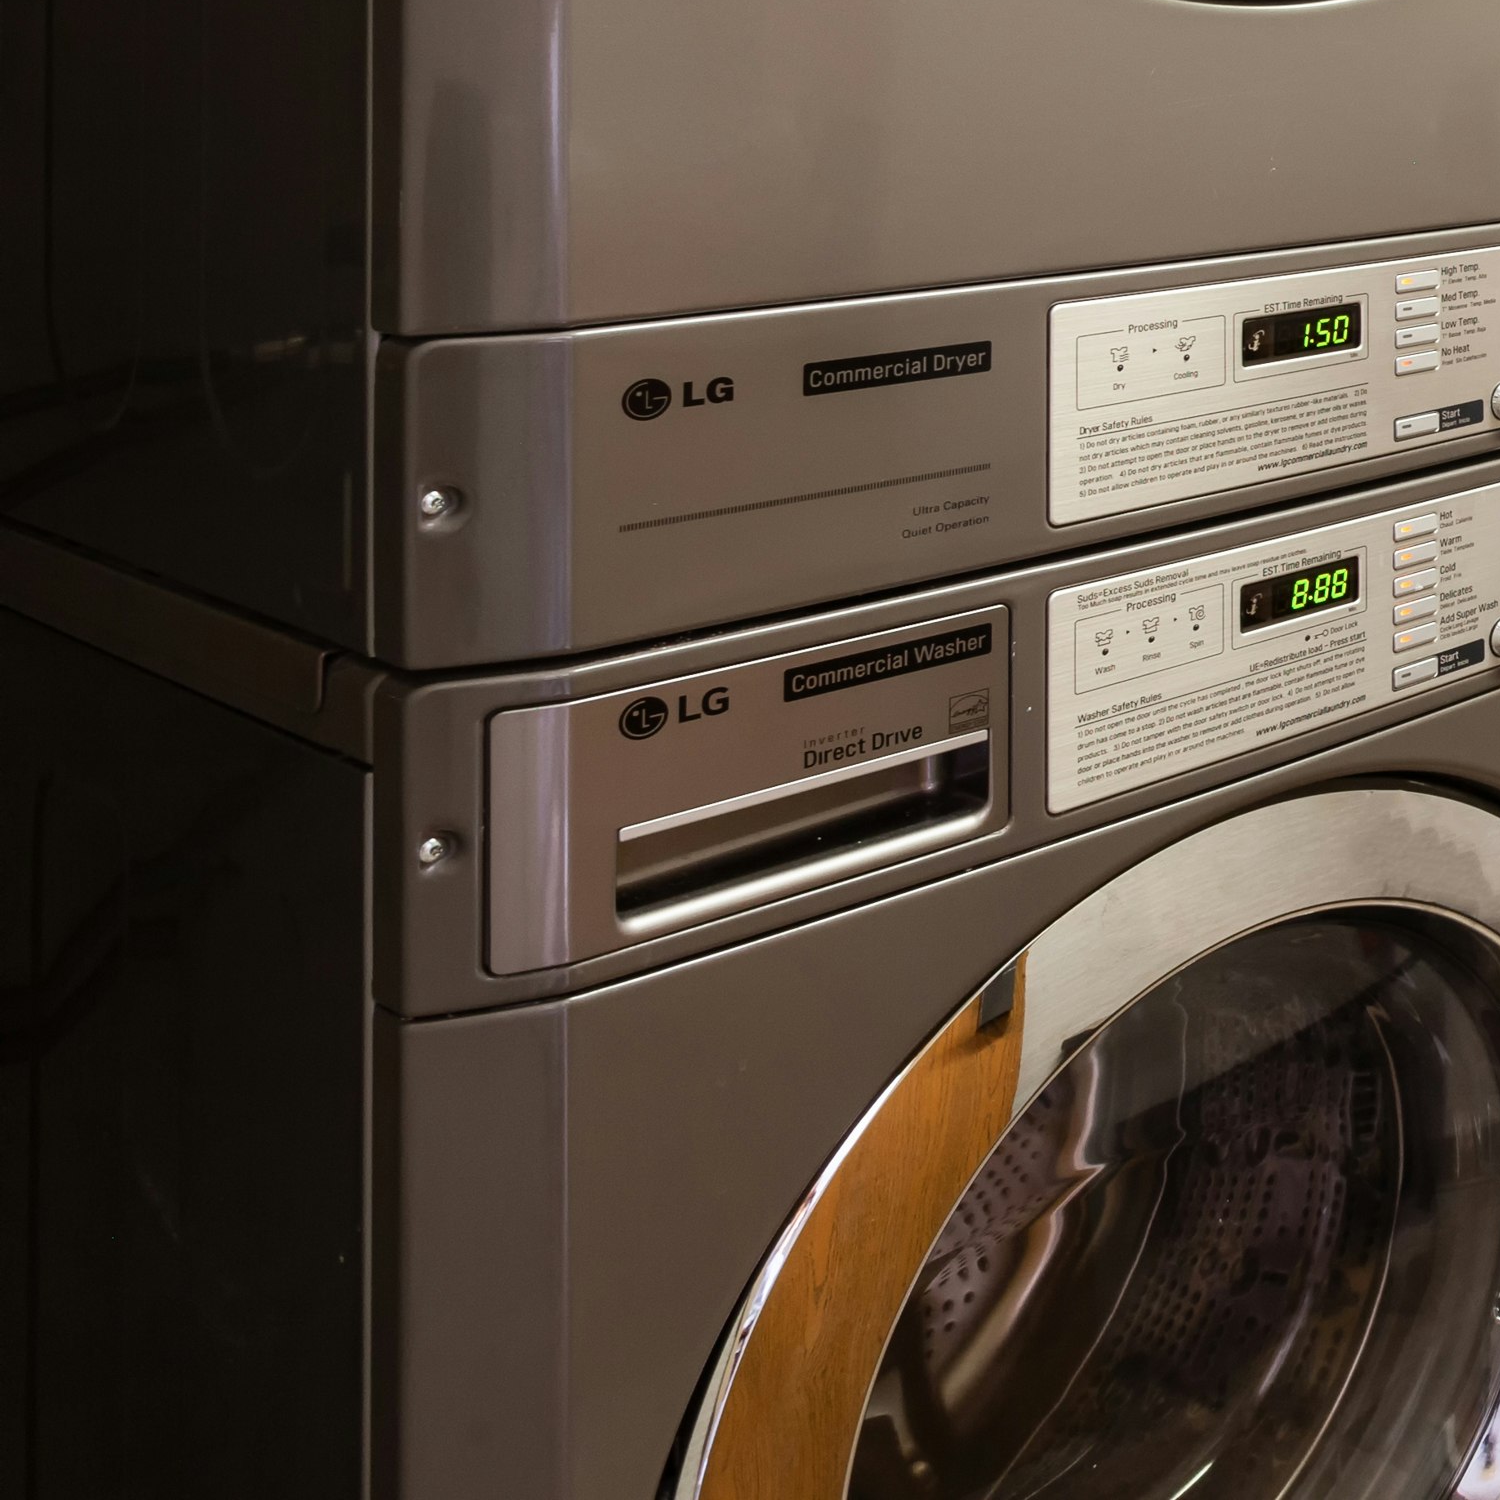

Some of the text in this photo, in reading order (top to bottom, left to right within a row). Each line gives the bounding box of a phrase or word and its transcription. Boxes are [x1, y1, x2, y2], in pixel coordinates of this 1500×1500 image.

[1441, 263, 1480, 277] High Temp.
[1303, 294, 1343, 308] Remaining
[1441, 292, 1457, 302] Med
[1128, 318, 1178, 335] Processing
[1441, 320, 1457, 330] Low
[1441, 344, 1470, 357] No Heat
[809, 350, 986, 389] Commercial Dryer
[1173, 370, 1199, 381] Cooling
[682, 376, 734, 408] LG
[1113, 383, 1126, 391] Dry
[1441, 407, 1461, 420] Start
[1079, 415, 1153, 436] Dryer Safety Rules
[1257, 441, 1368, 472] www.lgcommerciallaundry.com
[912, 495, 991, 517] Ultra Capacity
[1439, 510, 1453, 521] Hot
[902, 516, 990, 539] Quiet Operation
[1439, 534, 1462, 548] Warm
[1300, 549, 1342, 568] Remaining
[1439, 562, 1457, 575] Cold
[1077, 568, 1189, 604] Suds=Excess Suds Removal
[1439, 584, 1473, 601] Delicates
[1126, 591, 1177, 613] Processing
[1440, 614, 1455, 625] Add
[1456, 608, 1477, 621] Super
[1478, 600, 1499, 613] Wash
[1330, 621, 1358, 634] Door Lock
[1189, 640, 1205, 650] Spin
[1308, 644, 1323, 655] load
[1330, 637, 1349, 648] Press
[1350, 631, 1366, 642] start
[791, 634, 986, 694] Commercial Washer
[1142, 652, 1162, 662] Rinse
[1440, 651, 1459, 664] Start
[1095, 664, 1116, 675] Wash
[678, 686, 730, 724] LG
[1077, 692, 1162, 724] Washer Safety Rules
[1256, 694, 1366, 736] www.lgcommerciallaundry.com
[804, 726, 865, 749] Inverter
[804, 725, 923, 769] Direct Drive
